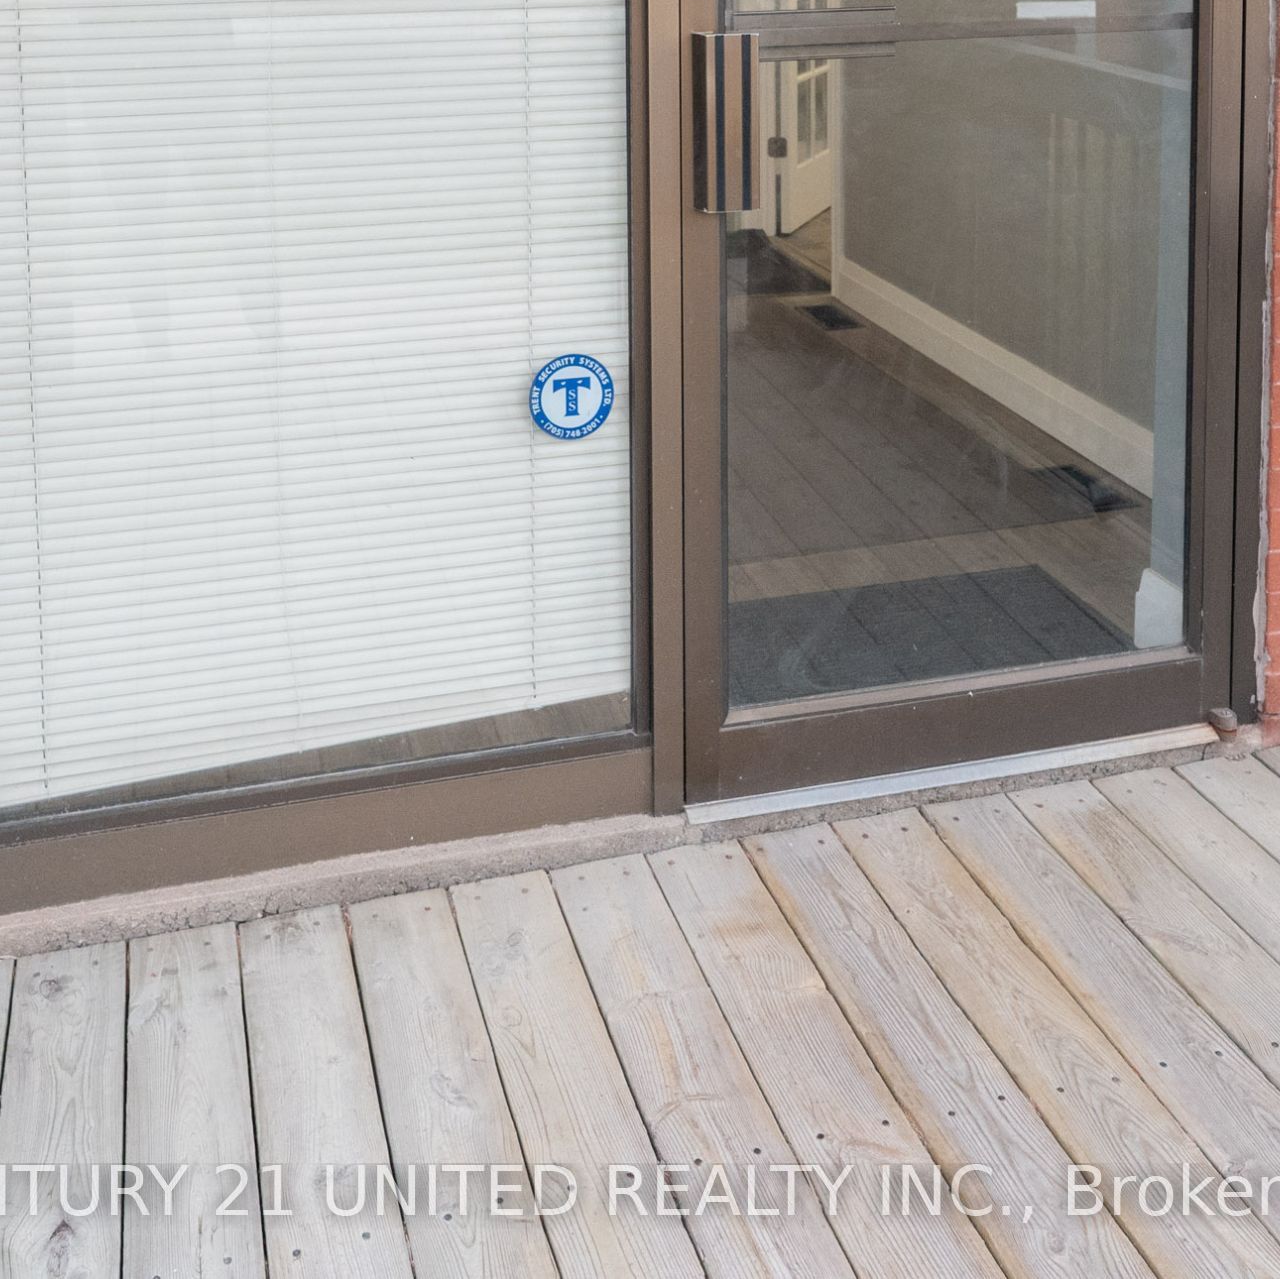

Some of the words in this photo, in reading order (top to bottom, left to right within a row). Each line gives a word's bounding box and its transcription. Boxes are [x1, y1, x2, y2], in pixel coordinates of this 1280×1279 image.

[531, 386, 540, 415] TRENT
[538, 356, 575, 382] SECURITY
[578, 356, 609, 385] SYSTEMS
[543, 422, 564, 438] (705)
